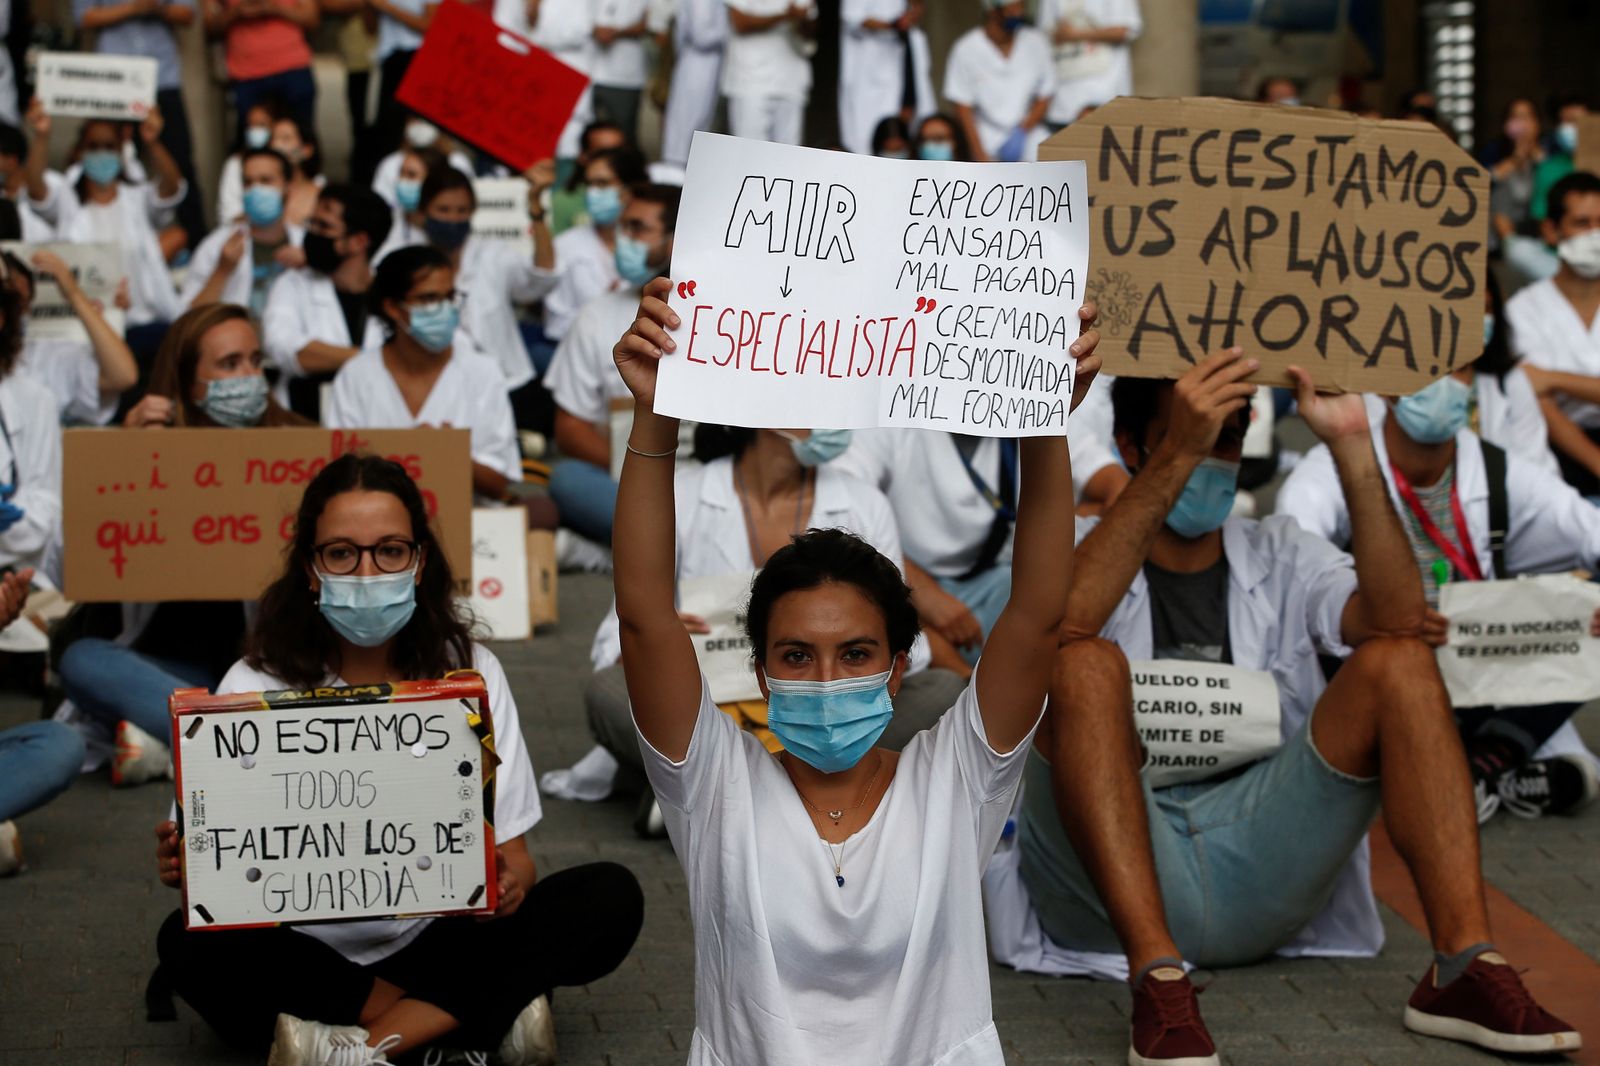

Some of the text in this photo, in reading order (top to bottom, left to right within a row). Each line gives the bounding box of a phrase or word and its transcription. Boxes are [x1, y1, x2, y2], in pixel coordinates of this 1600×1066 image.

[725, 176, 857, 263] MIR
[909, 178, 1073, 223] EXPLOTADA
[903, 222, 1043, 261] CANSADA
[1088, 196, 1482, 300] US APLAUSOS
[896, 260, 1076, 300] MAL PAGADA
[936, 304, 1067, 350] CREMADA
[1127, 279, 1460, 378] AHORA!!
[923, 342, 1073, 395] DESMOTIVADA
[889, 383, 1064, 430] MAL FORMADA
[194, 462, 222, 489] a
[96, 509, 165, 580] qui
[193, 514, 261, 544] ens
[705, 638, 754, 652] DERE
[1458, 622, 1482, 636] NO
[1487, 623, 1507, 635] ES
[1131, 673, 1230, 689] UELDO DE
[1133, 700, 1243, 717] CARIO, SIN
[213, 711, 451, 760] NO ESTAMOS
[1139, 728, 1225, 743] MITE DE
[271, 769, 377, 811] TODOS
[206, 819, 464, 872] FALTAN LOS DE
